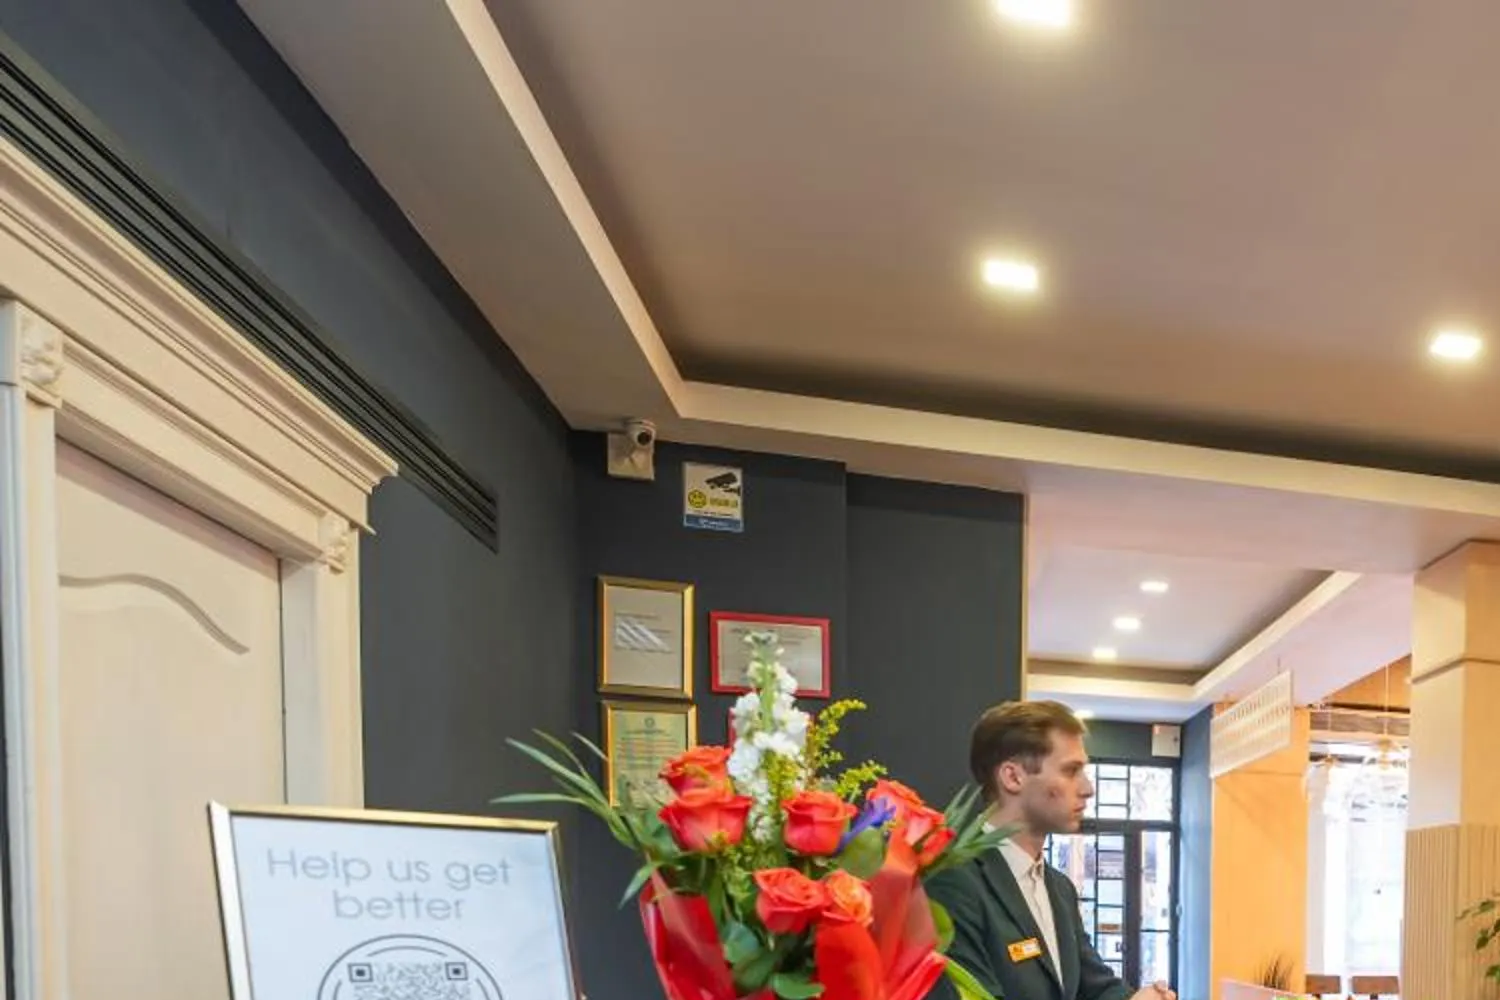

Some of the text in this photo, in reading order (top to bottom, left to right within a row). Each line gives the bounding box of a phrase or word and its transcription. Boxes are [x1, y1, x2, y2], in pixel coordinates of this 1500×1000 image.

[266, 848, 513, 890] Help us get
[332, 889, 465, 920] better
